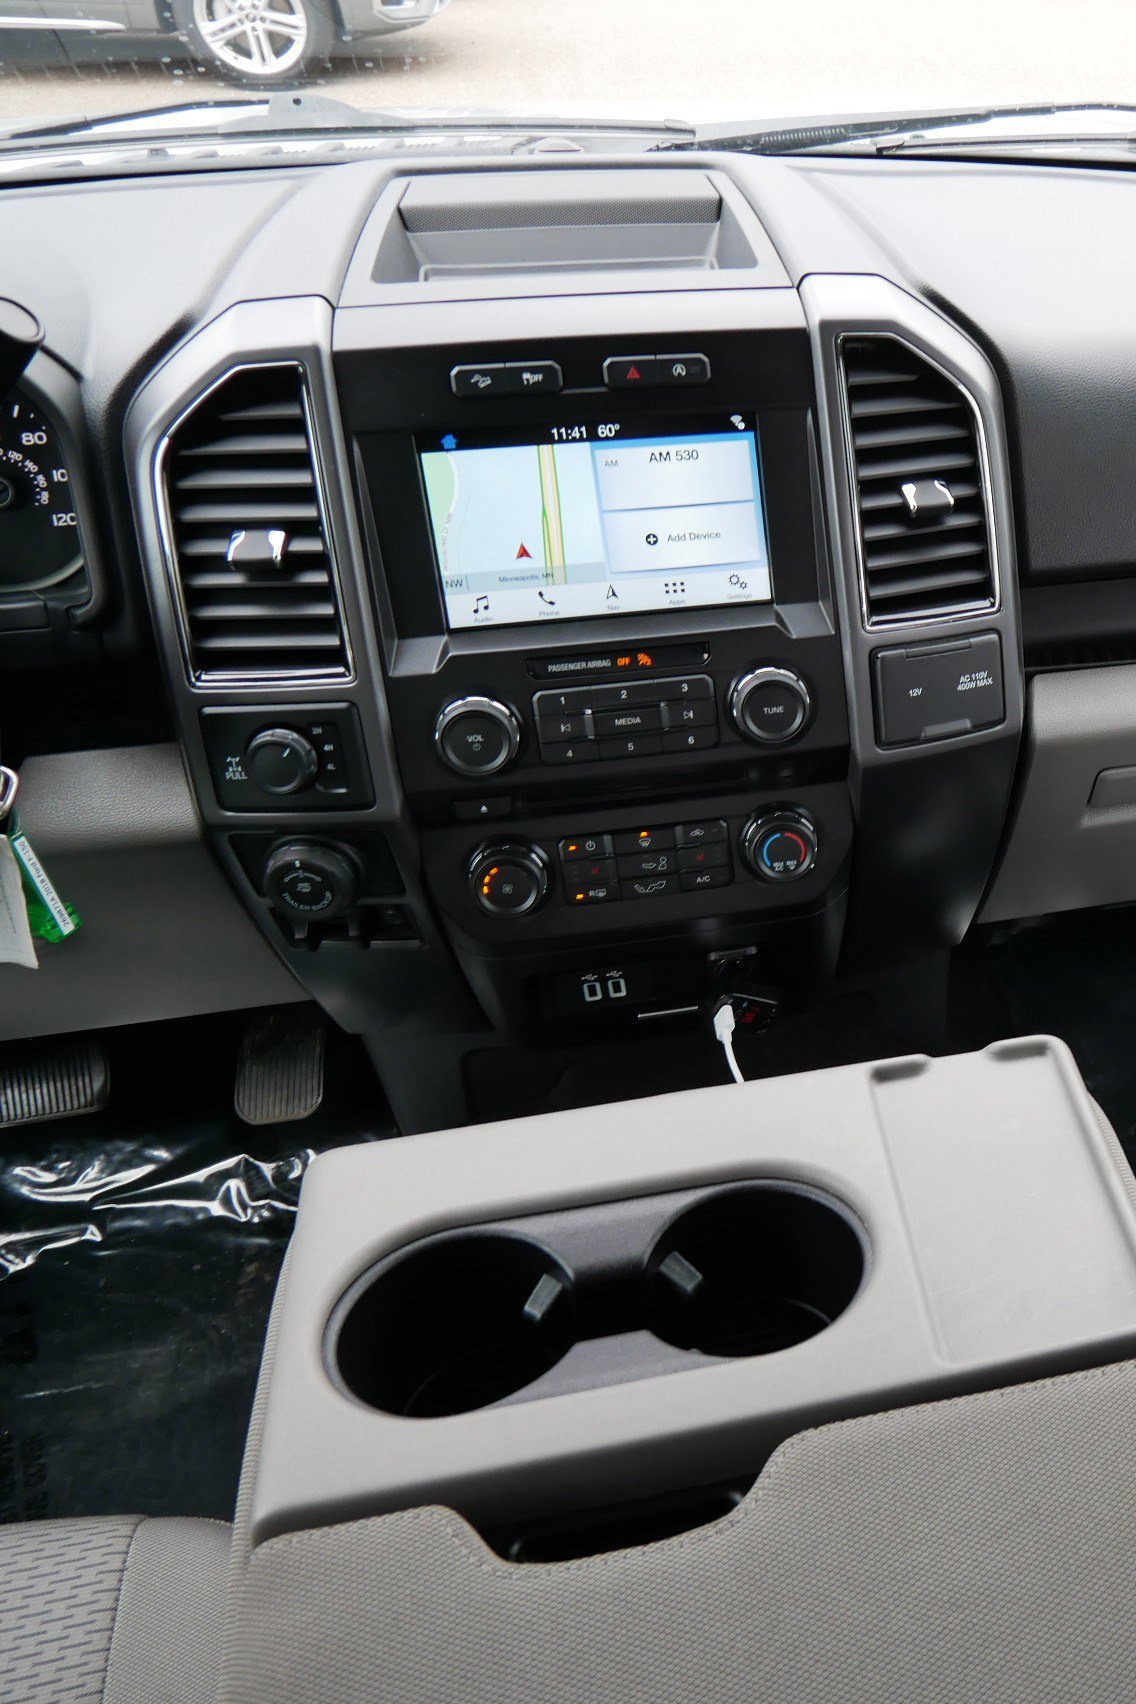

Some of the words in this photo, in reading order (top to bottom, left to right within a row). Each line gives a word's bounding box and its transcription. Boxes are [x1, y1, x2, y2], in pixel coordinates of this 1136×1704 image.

[530, 373, 544, 382] OFF
[551, 425, 588, 441] 11:41
[597, 423, 620, 438] 60°
[21, 431, 47, 446] 80
[7, 449, 23, 461] 120
[649, 451, 671, 463] AM
[675, 449, 699, 461] 530
[24, 459, 38, 472] 140
[604, 459, 619, 467] AM
[52, 469, 68, 482] 10
[667, 532, 687, 542] Add
[689, 531, 721, 541] Device
[445, 579, 463, 588] NW
[548, 661, 587, 673] PASSENGER
[587, 659, 611, 669] AIRBAG
[617, 657, 631, 666] OFF
[959, 674, 970, 683] AC
[971, 670, 988, 681] 110V
[681, 683, 689, 692] 3
[957, 681, 976, 691] 400W
[976, 677, 993, 688] MAX
[620, 690, 627, 699] 2
[908, 687, 923, 697] 12V
[559, 696, 566, 705] 1
[763, 705, 784, 715] TUNE
[614, 716, 641, 727] MEDIA
[312, 727, 323, 735] 2H
[466, 734, 484, 742] VOL
[688, 736, 695, 745] 6
[627, 742, 634, 751] 5
[566, 750, 573, 758] 4
[225, 771, 248, 780] PULL
[696, 875, 710, 883] A/C
